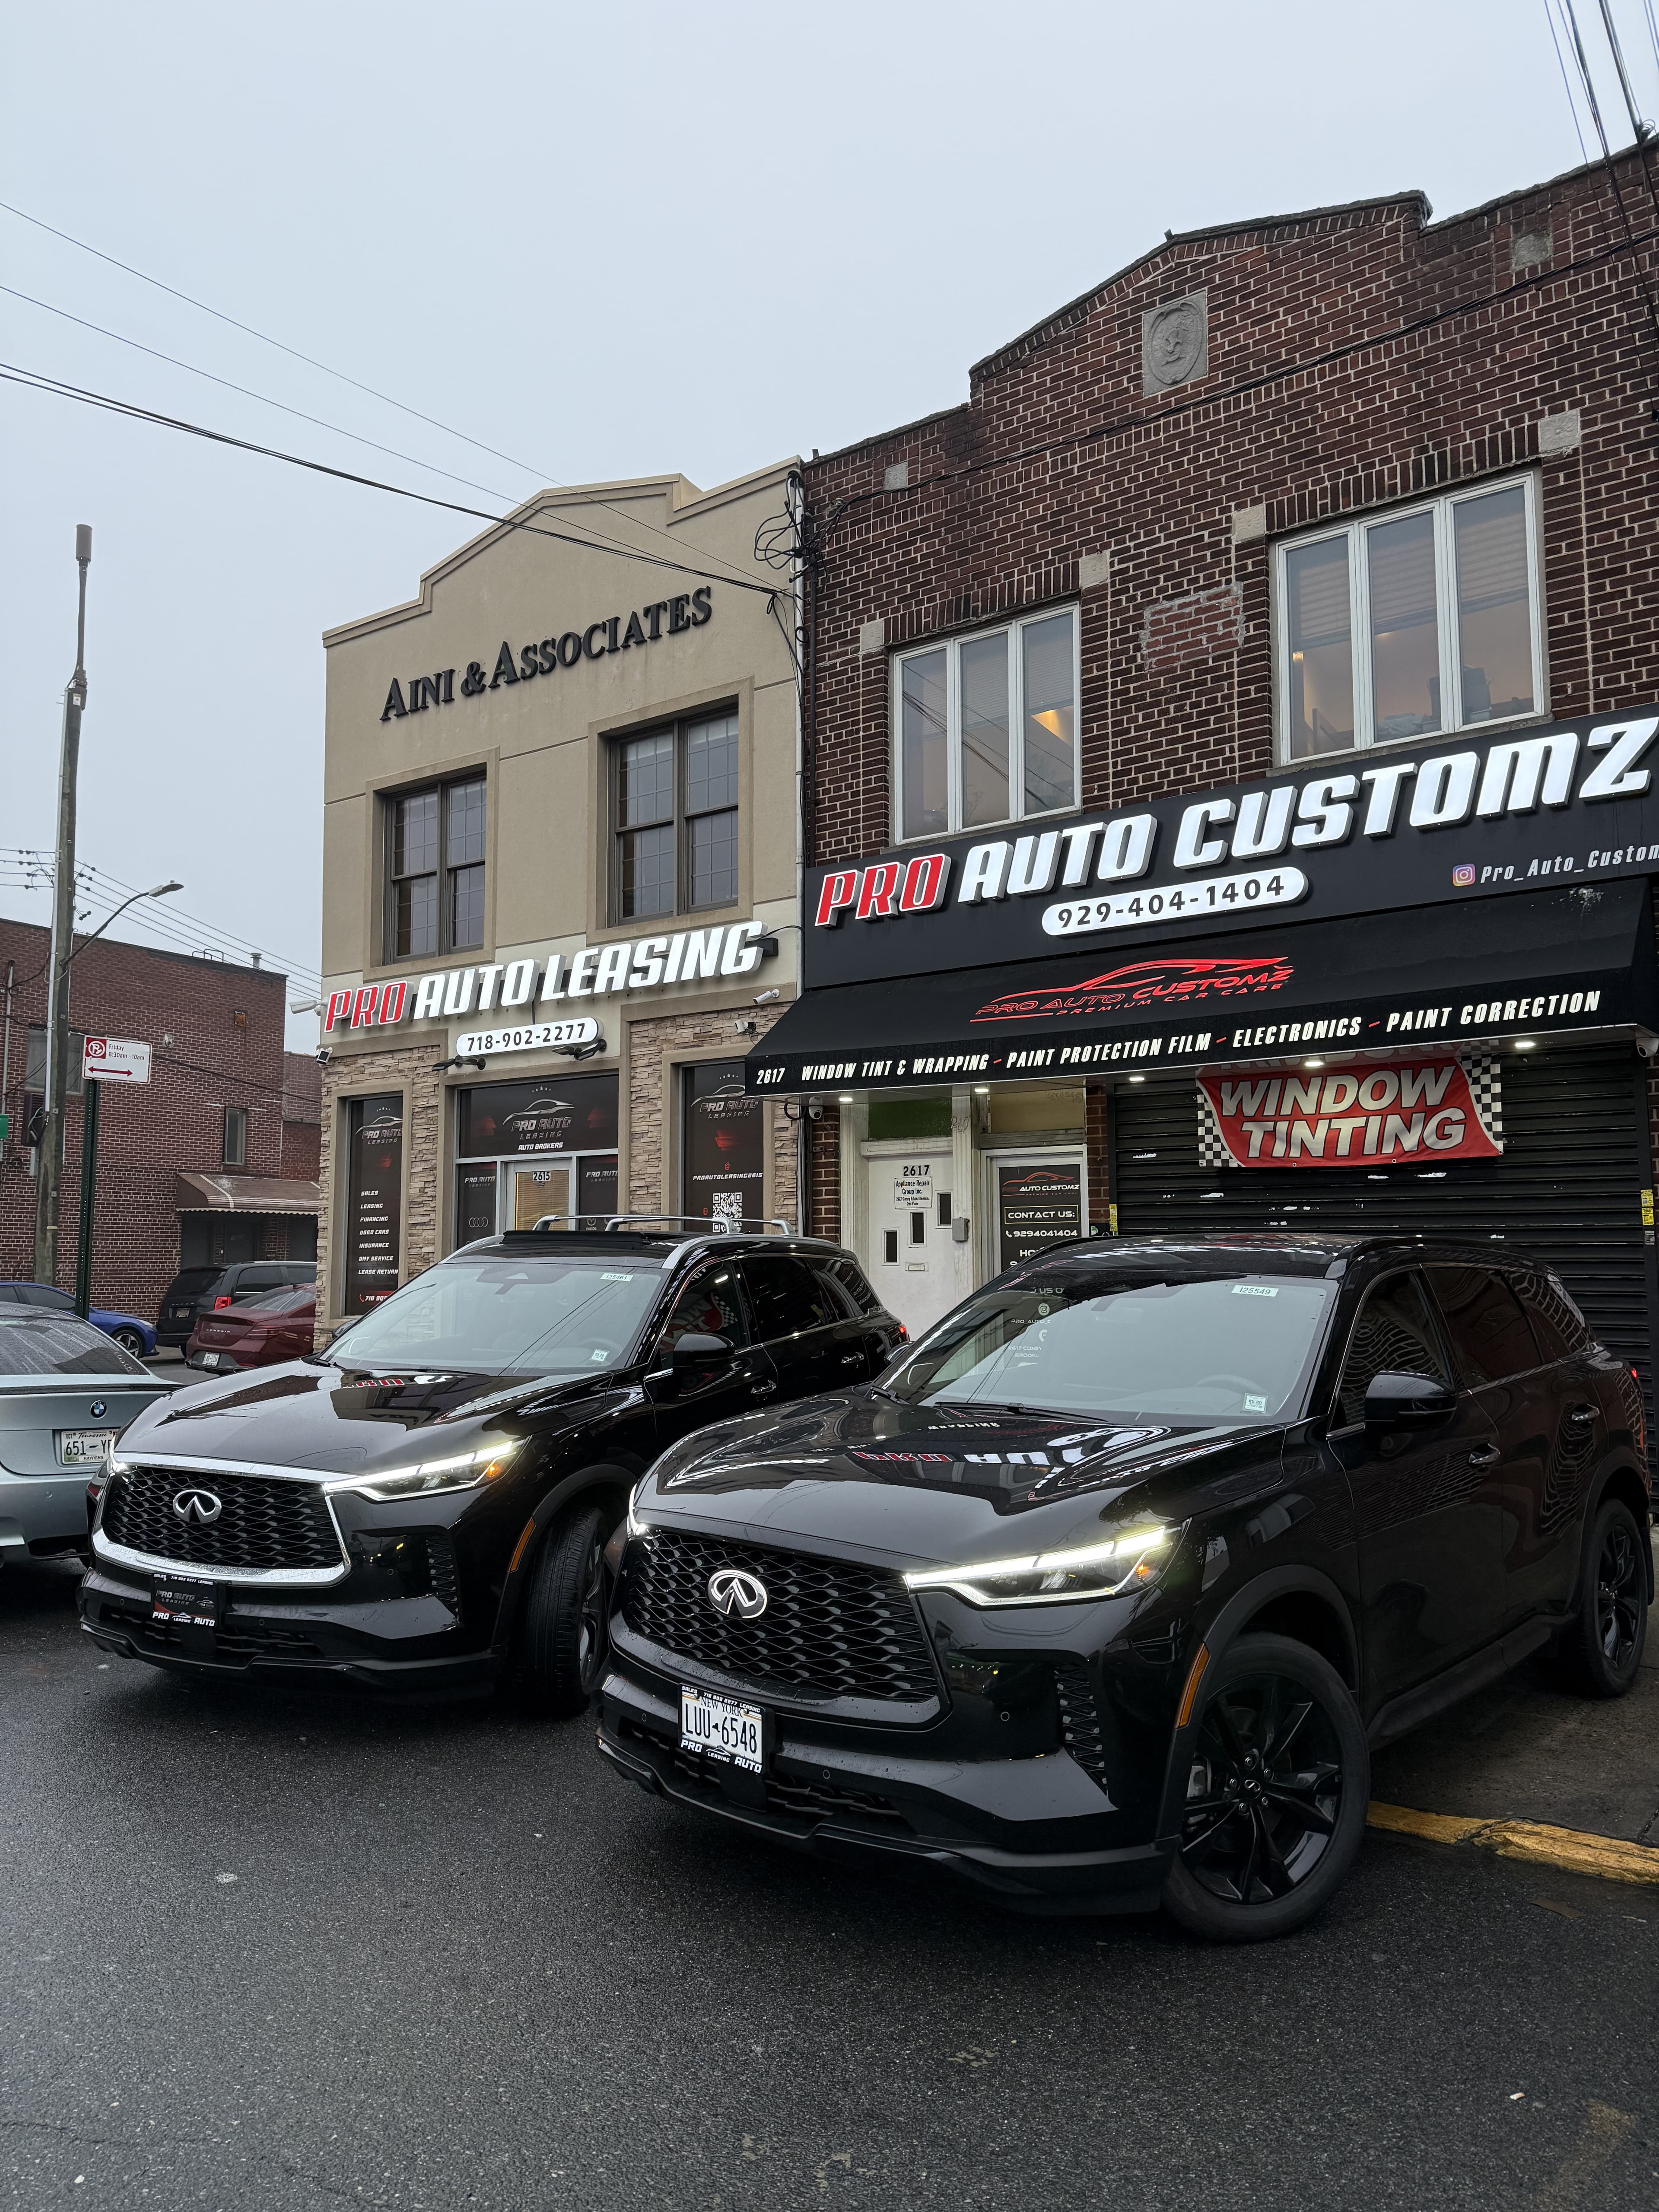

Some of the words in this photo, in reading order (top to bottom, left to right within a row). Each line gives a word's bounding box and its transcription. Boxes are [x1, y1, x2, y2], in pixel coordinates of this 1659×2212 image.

[379, 668, 455, 721] AINI
[461, 661, 486, 696] &
[488, 585, 712, 689] ASSOCIATES
[814, 853, 948, 928] PRO
[957, 814, 1155, 904] AUTO
[1173, 717, 1659, 868] CUSTOMZ
[1058, 875, 1285, 928] 929-404-1404
[324, 980, 410, 1033] PRO
[413, 958, 537, 1020] AUTO
[540, 920, 765, 1001] LEASING
[976, 1001, 1039, 1015] PRO
[1040, 994, 1125, 1010] AUTO
[1056, 999, 1151, 1015] PREMIUM
[1164, 992, 1207, 1002] CAR
[1221, 983, 1281, 995] CARE
[467, 1022, 585, 1052] 718-902-2277
[756, 1068, 785, 1084] 2617
[801, 1063, 856, 1081] WINDOW
[862, 1060, 892, 1077] TINT
[898, 1060, 906, 1075] &
[912, 1054, 988, 1074] WRAPPING
[1006, 1049, 1055, 1068] PAINT
[1060, 1039, 1162, 1063] PROTECTION
[1168, 1033, 1211, 1054] FILM
[1233, 1017, 1362, 1048] ELECTRONICS
[1387, 1007, 1452, 1032] PAINT
[1460, 991, 1601, 1026] CORRECTION
[1220, 1065, 1456, 1117] WINDOW
[699, 1101, 725, 1113] PRO
[511, 1120, 537, 1132] PRO
[538, 1117, 572, 1130] AUTO
[1240, 1107, 1467, 1158] TINTING
[520, 1131, 563, 1140] LEASING
[535, 1142, 563, 1150] BROKERS
[533, 1171, 550, 1181] 2615
[903, 1165, 930, 1176] 2617
[156, 1590, 173, 1598] PRO
[152, 1611, 169, 1620] PRO
[194, 1617, 215, 1627] AUTO
[700, 1697, 719, 1710] NEW
[721, 1702, 744, 1718] YORK
[740, 1703, 761, 1713] LEASING
[680, 1739, 702, 1753] PRO
[734, 1756, 762, 1773] AUTO
[708, 1751, 730, 1763] LEASING
